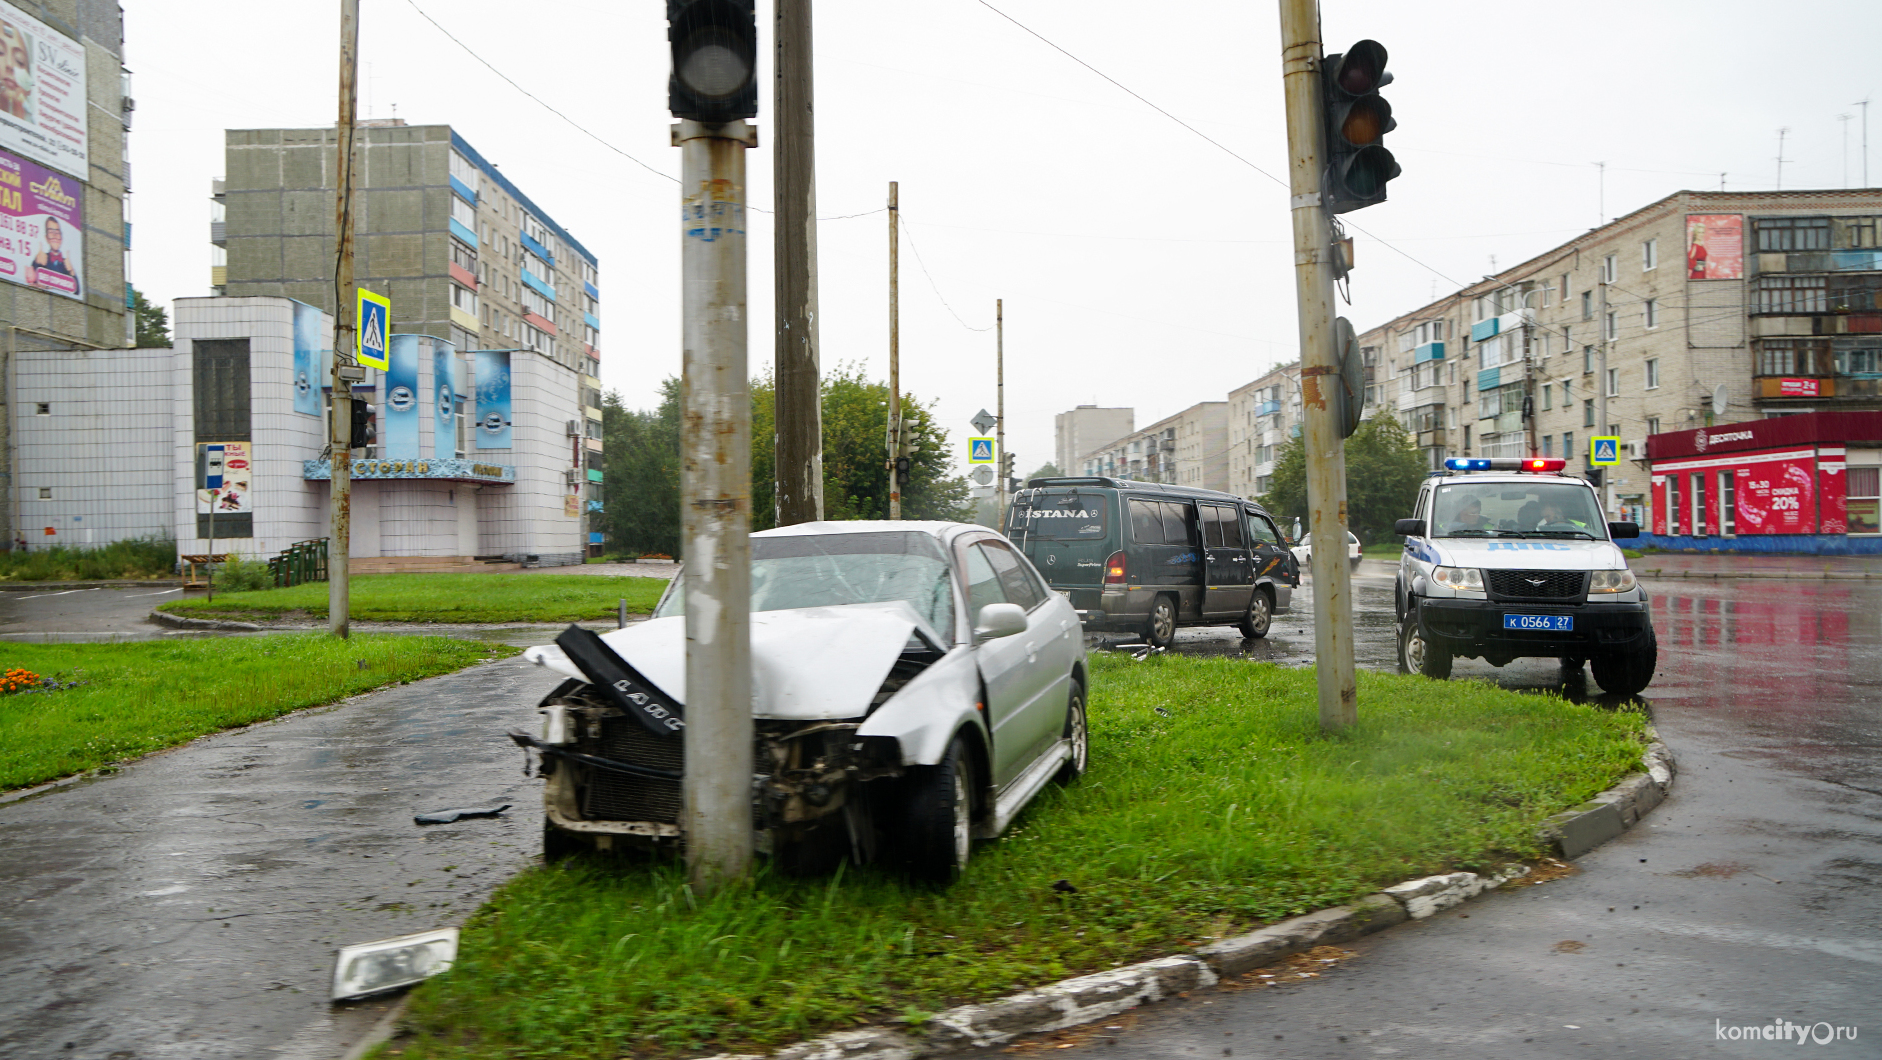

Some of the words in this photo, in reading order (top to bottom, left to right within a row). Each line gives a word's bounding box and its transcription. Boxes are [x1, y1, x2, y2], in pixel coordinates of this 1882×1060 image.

[18, 239, 32, 256] 15
[1708, 430, 1754, 446] ДЕСЯТОЧКА
[349, 461, 429, 475] СТОРАН
[1771, 496, 1800, 510] 20%
[1025, 509, 1089, 519] ISTANA
[1487, 542, 1571, 552] ДПС
[1521, 616, 1551, 628] 0566
[1557, 617, 1569, 626] 27
